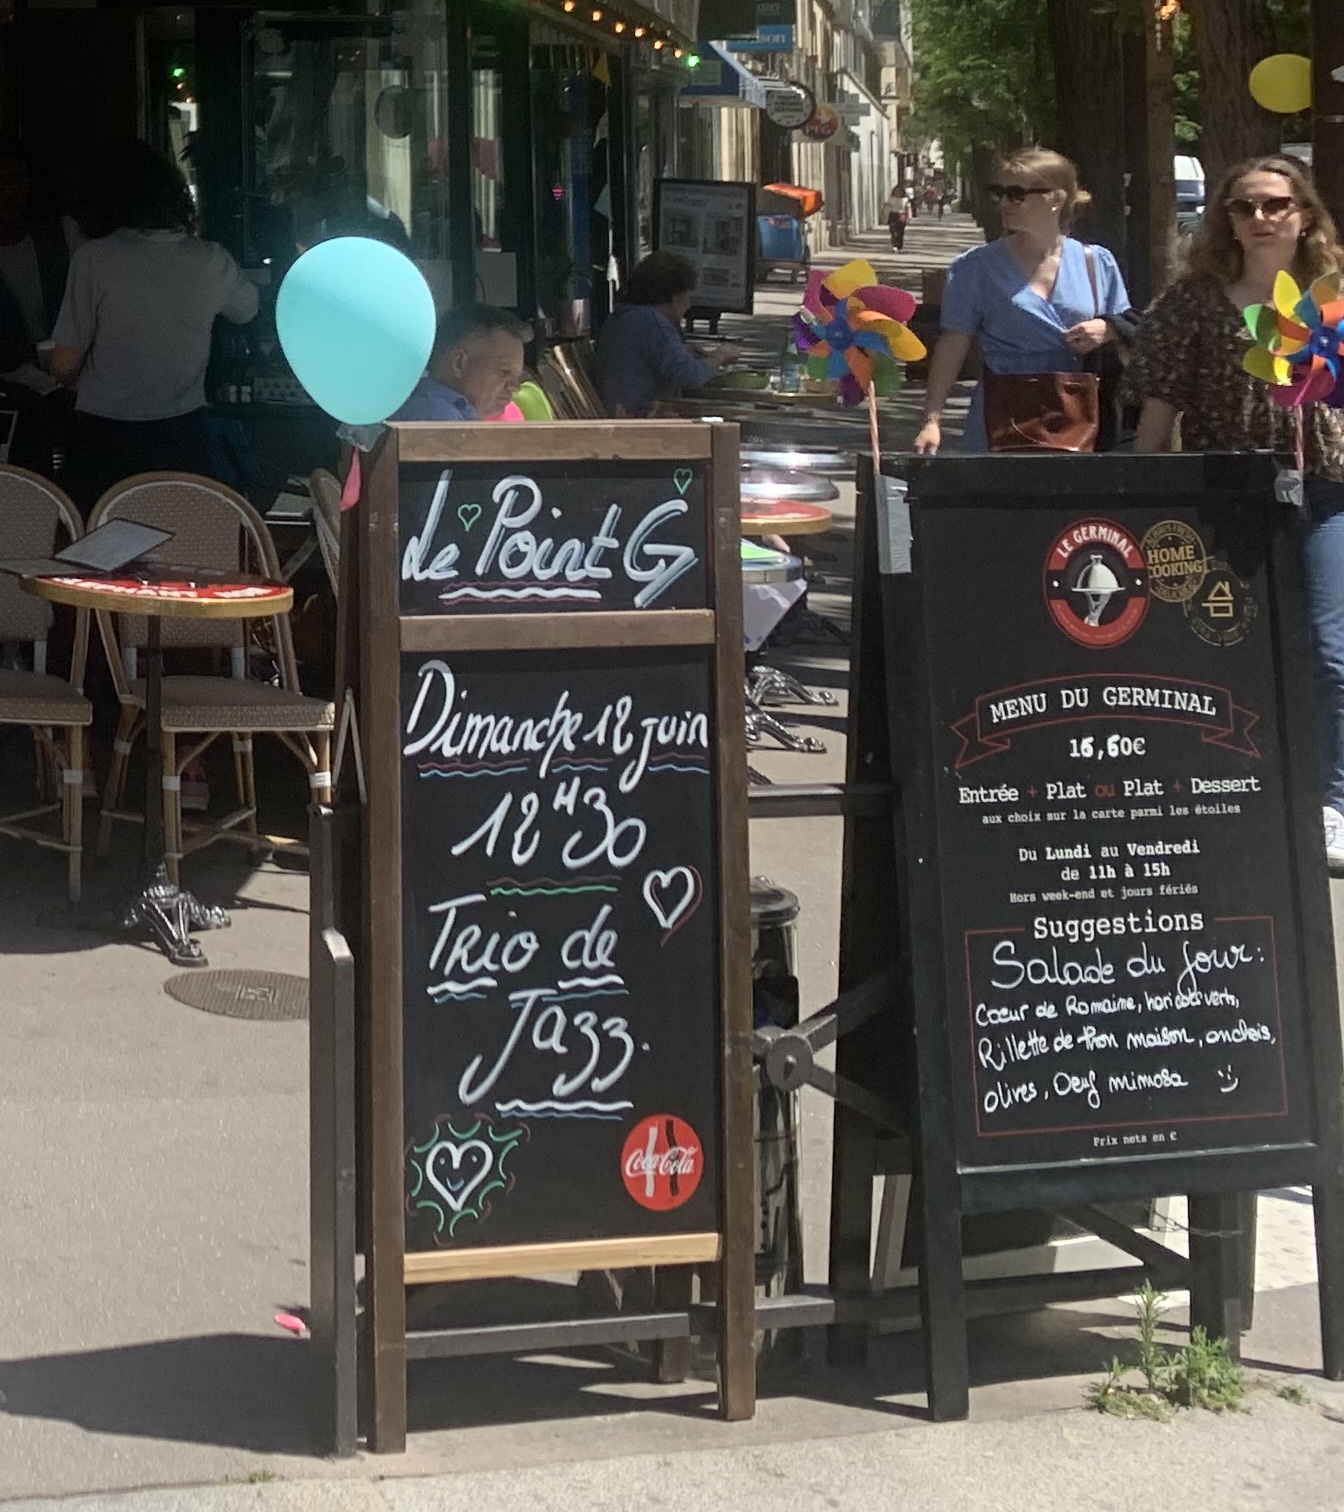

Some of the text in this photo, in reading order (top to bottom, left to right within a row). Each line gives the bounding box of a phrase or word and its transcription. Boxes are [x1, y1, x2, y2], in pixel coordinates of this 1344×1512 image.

[401, 467, 700, 609] Le Point G
[1056, 524, 1136, 559] LE GERMINAL
[1146, 544, 1196, 565] HOME
[990, 686, 1217, 724] MENU DU GERMINAL
[402, 659, 709, 794] Dimanche 12 juin
[958, 783, 1020, 804] Entrée
[1045, 781, 1088, 800] Plat
[1122, 778, 1165, 797] Plat
[1190, 775, 1262, 794] Dessert
[982, 802, 1242, 824] aux choix sur la carte parmi les étoiles
[1018, 839, 1201, 862] Du Lundi au Vendredi
[1061, 862, 1172, 881] de 11h à 15h
[1009, 883, 1199, 903] Hors week-end et jours fériés
[561, 903, 618, 970] de
[1033, 908, 1205, 942] Suggestions
[991, 940, 1117, 989] Salade
[1126, 942, 1167, 978] du
[1035, 1000, 1059, 1019] de
[978, 1030, 1050, 1072] Rillette
[1053, 1028, 1075, 1052] de
[1108, 1067, 1190, 1094] mimosa
[1093, 1134, 1119, 1147] Prix
[1123, 1133, 1148, 1145] nets
[1152, 1132, 1166, 1143] en
